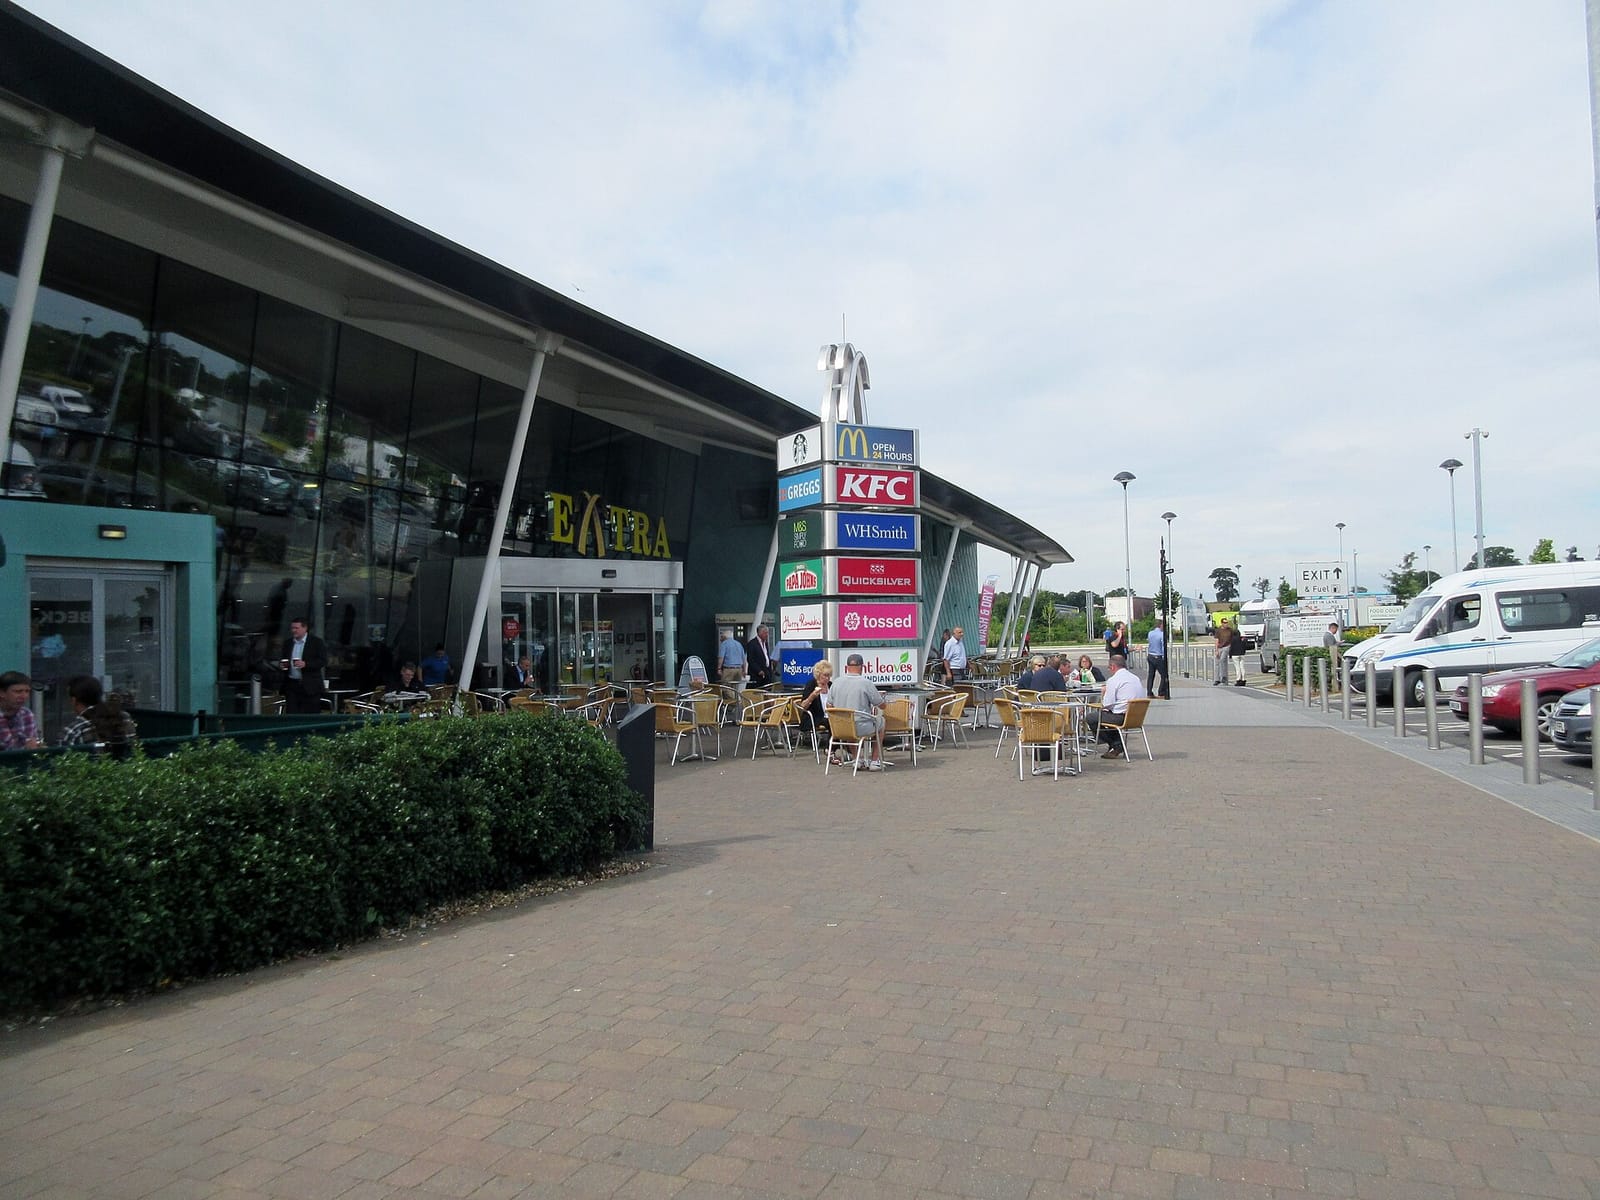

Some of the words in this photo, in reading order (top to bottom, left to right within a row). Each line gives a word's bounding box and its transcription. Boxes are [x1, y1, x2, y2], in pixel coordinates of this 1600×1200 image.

[872, 442, 895, 452] OPEN
[872, 451, 882, 459] 24
[883, 452, 913, 461] HOURS
[787, 478, 820, 500] GREGGS
[840, 473, 908, 501] KFC
[546, 491, 672, 558] EXTRA
[845, 523, 908, 540] WHSmith
[842, 575, 912, 586] QUICKSILVER
[1302, 570, 1331, 581] EXIT
[1312, 585, 1330, 593] Fuel
[981, 588, 994, 608] DRY
[863, 614, 912, 629] tossed
[783, 662, 802, 676] Regus
[875, 656, 913, 674] leaves
[892, 674, 912, 682] FOOD
